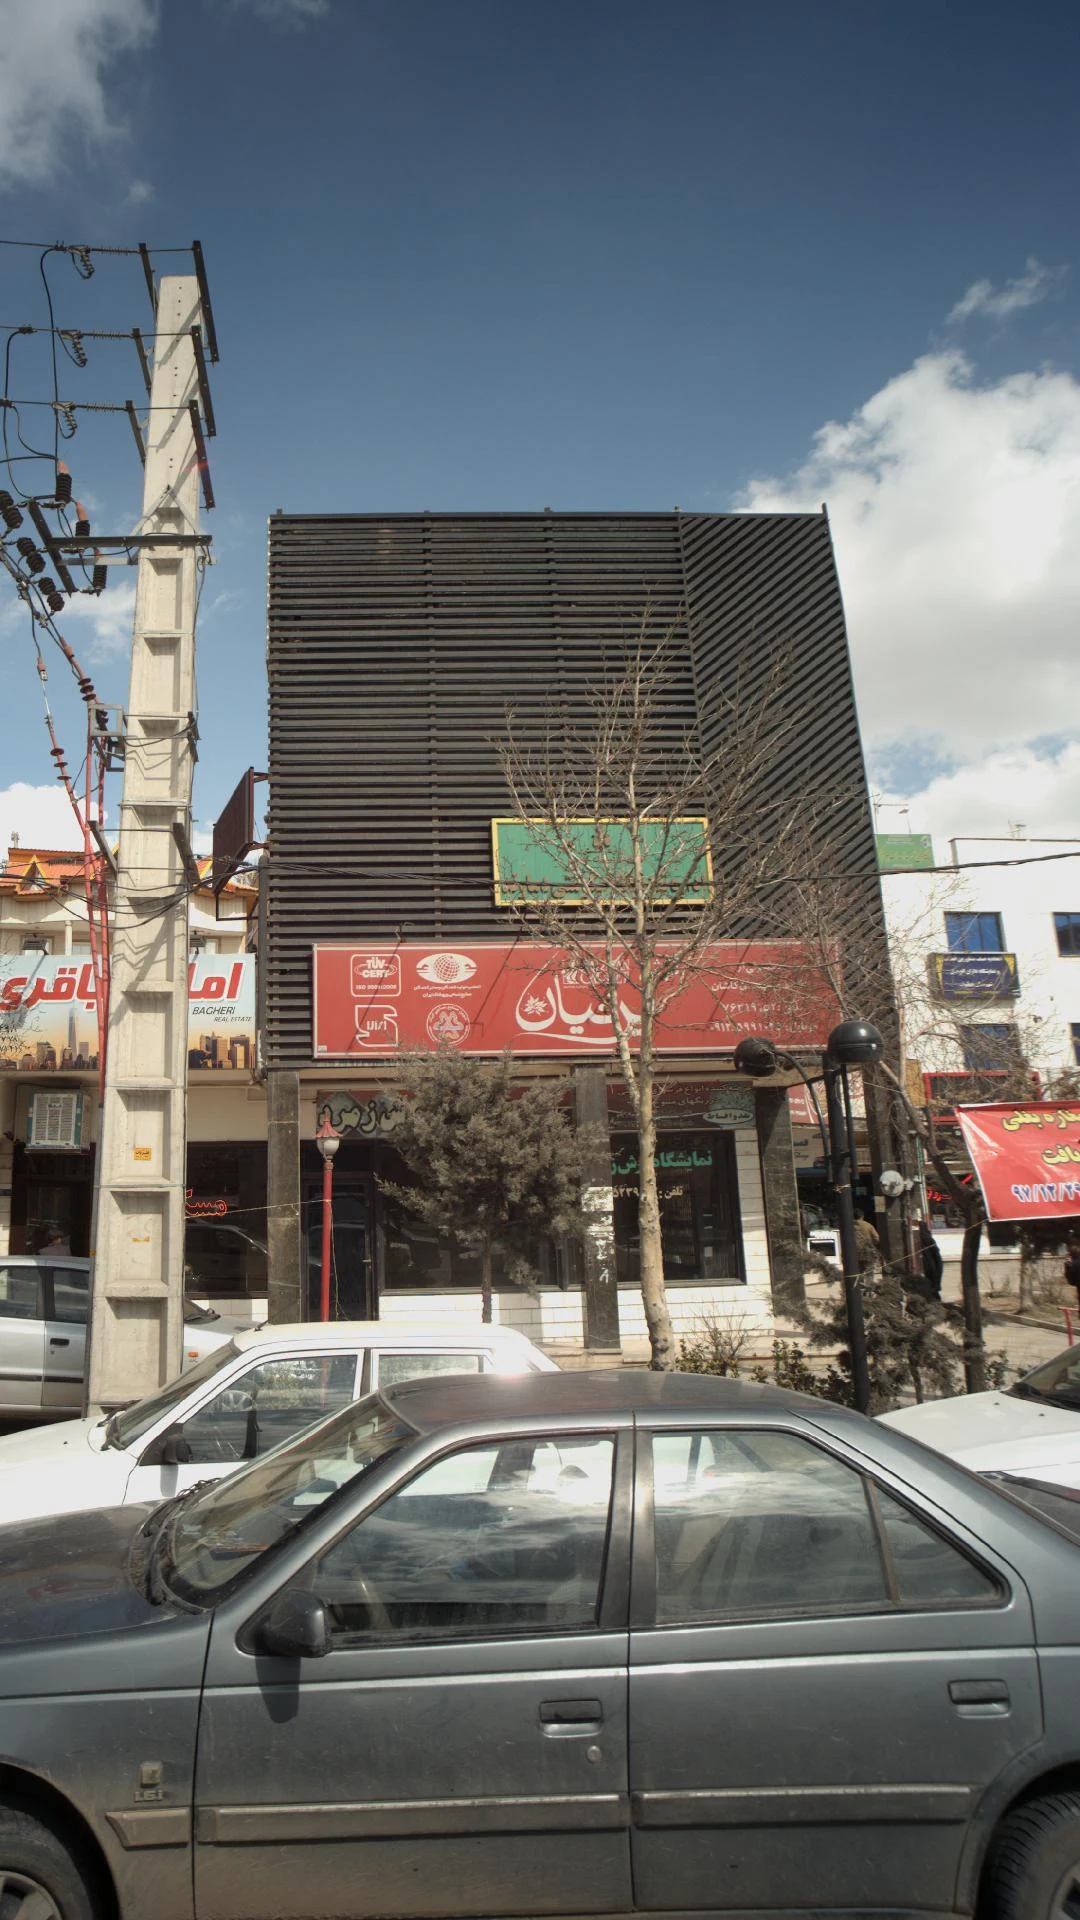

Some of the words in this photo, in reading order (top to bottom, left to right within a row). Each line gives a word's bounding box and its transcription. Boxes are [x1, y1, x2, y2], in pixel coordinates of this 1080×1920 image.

[366, 956, 386, 969] TÜV
[362, 969, 389, 978] CERT
[188, 962, 244, 999] امل
[192, 1006, 236, 1015] BAGHERI
[654, 1150, 713, 1172] نمایشگاه
